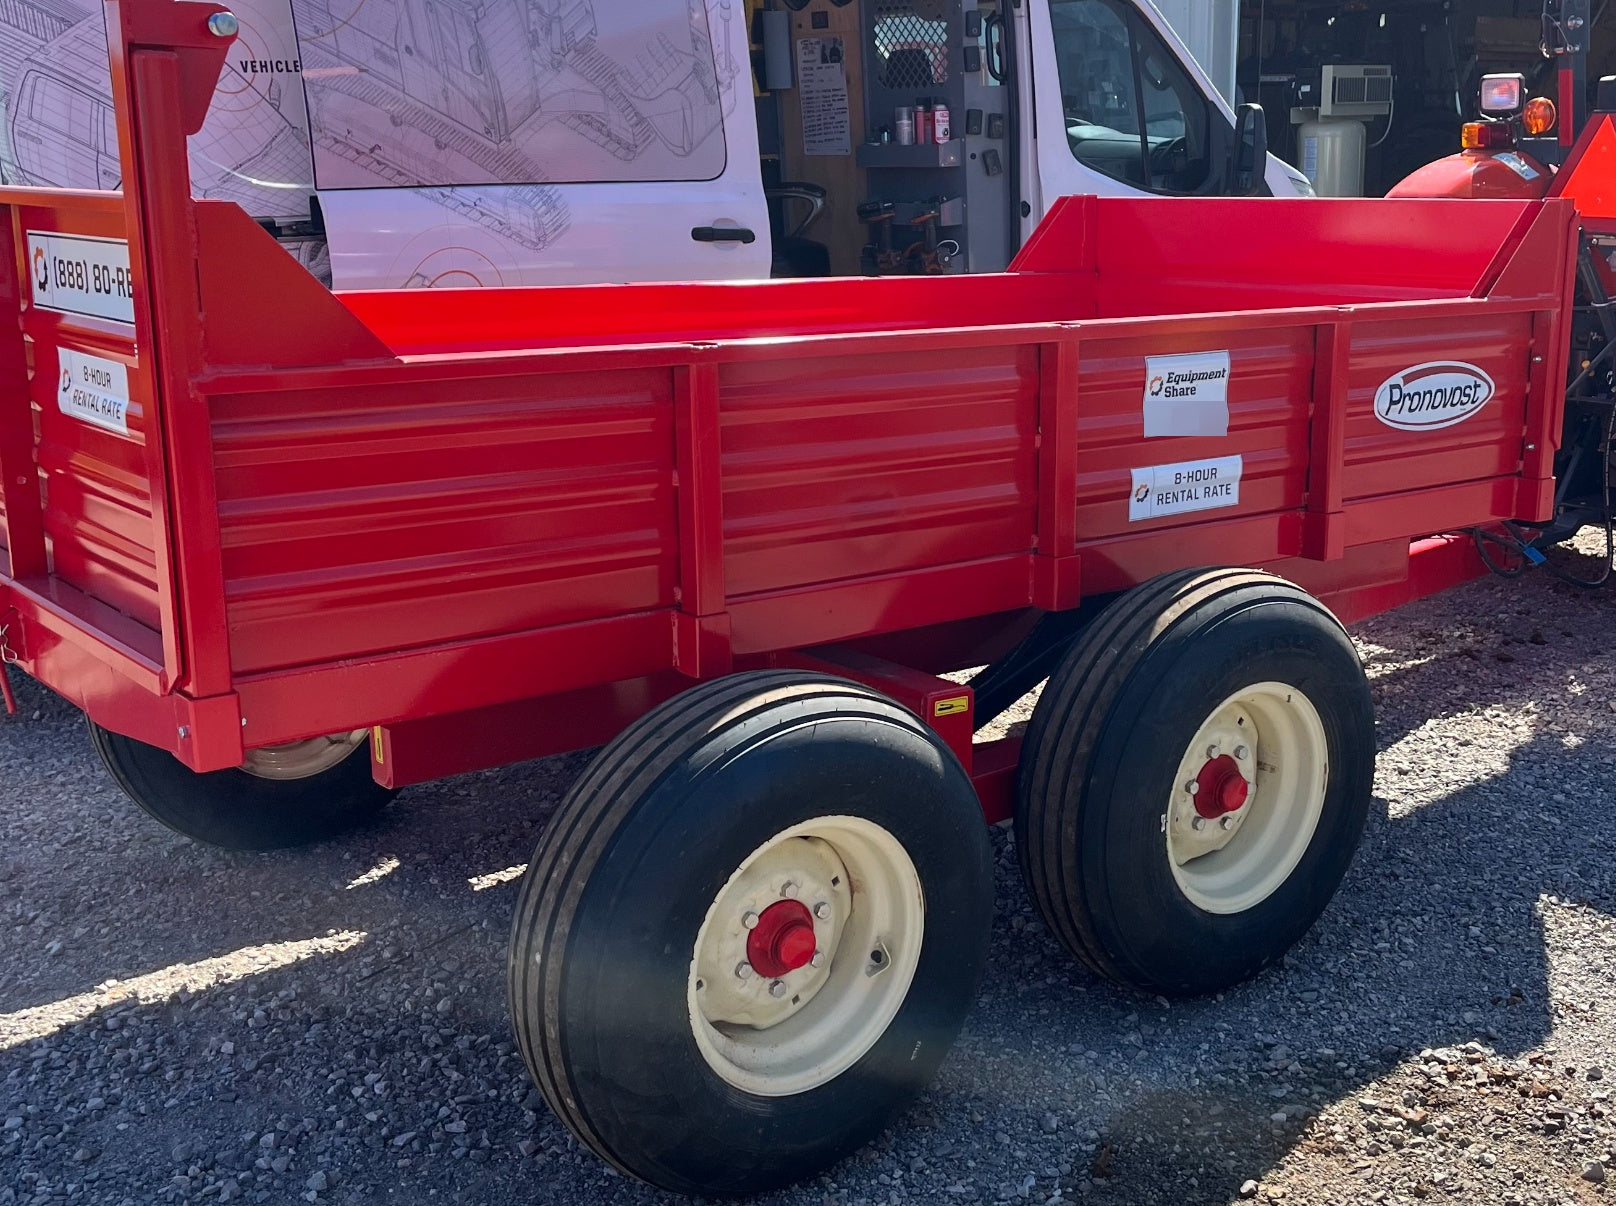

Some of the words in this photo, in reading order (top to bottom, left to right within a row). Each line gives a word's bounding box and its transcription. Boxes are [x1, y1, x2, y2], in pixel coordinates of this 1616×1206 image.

[240, 60, 300, 73] VEHICLE
[53, 255, 89, 294] (888)
[83, 365, 112, 390] 8-HOUR
[1166, 367, 1227, 385] Equipment
[1164, 385, 1197, 398] Share
[1384, 380, 1481, 416] Pronovost
[72, 389, 100, 412] RENTAL
[101, 399, 121, 420] RATE
[1174, 467, 1218, 485] 8-HOUR
[1156, 490, 1199, 506] RENTAL
[1203, 483, 1232, 499] RATE
